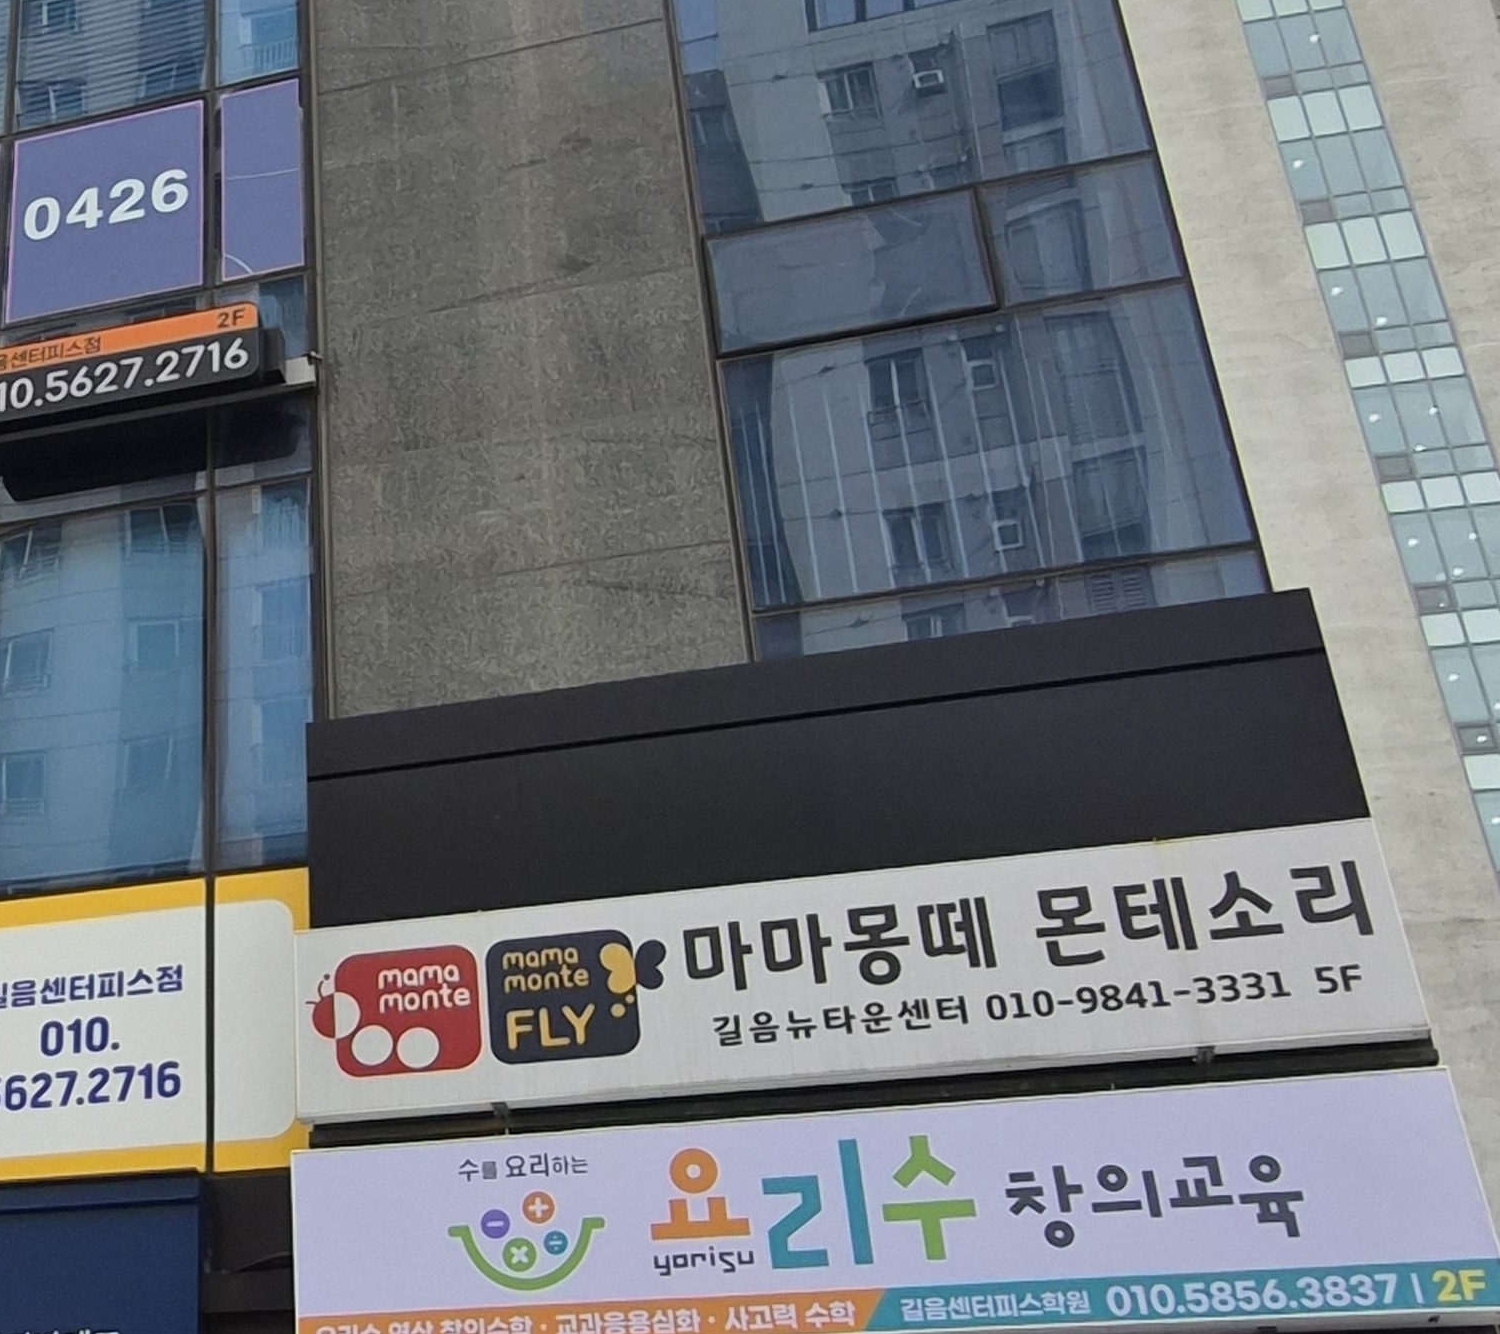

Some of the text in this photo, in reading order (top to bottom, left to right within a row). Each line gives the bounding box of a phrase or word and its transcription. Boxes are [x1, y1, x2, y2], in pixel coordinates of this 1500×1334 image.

[23, 168, 190, 241] 0426
[216, 308, 247, 328] 2F
[682, 860, 1375, 992] 마마몽떼 몬테소리
[502, 945, 580, 970] mama
[377, 963, 461, 992] mama
[503, 967, 590, 994] monte
[378, 984, 472, 1014] monte
[711, 963, 1364, 1048] 길음뉴타운센터 010-9841-3331 5F
[38, 1016, 122, 1058] 010.
[505, 1003, 596, 1051] FLY
[504, 1153, 589, 1180] 요리하는
[649, 1133, 1304, 1271] 요리수 창의교육
[652, 1246, 756, 1277] yorisu
[900, 1268, 1487, 1324] 길음센터피스학원 010.5856.3837 2F
[724, 1303, 798, 1333] 사고력
[804, 1300, 857, 1329] 수학
